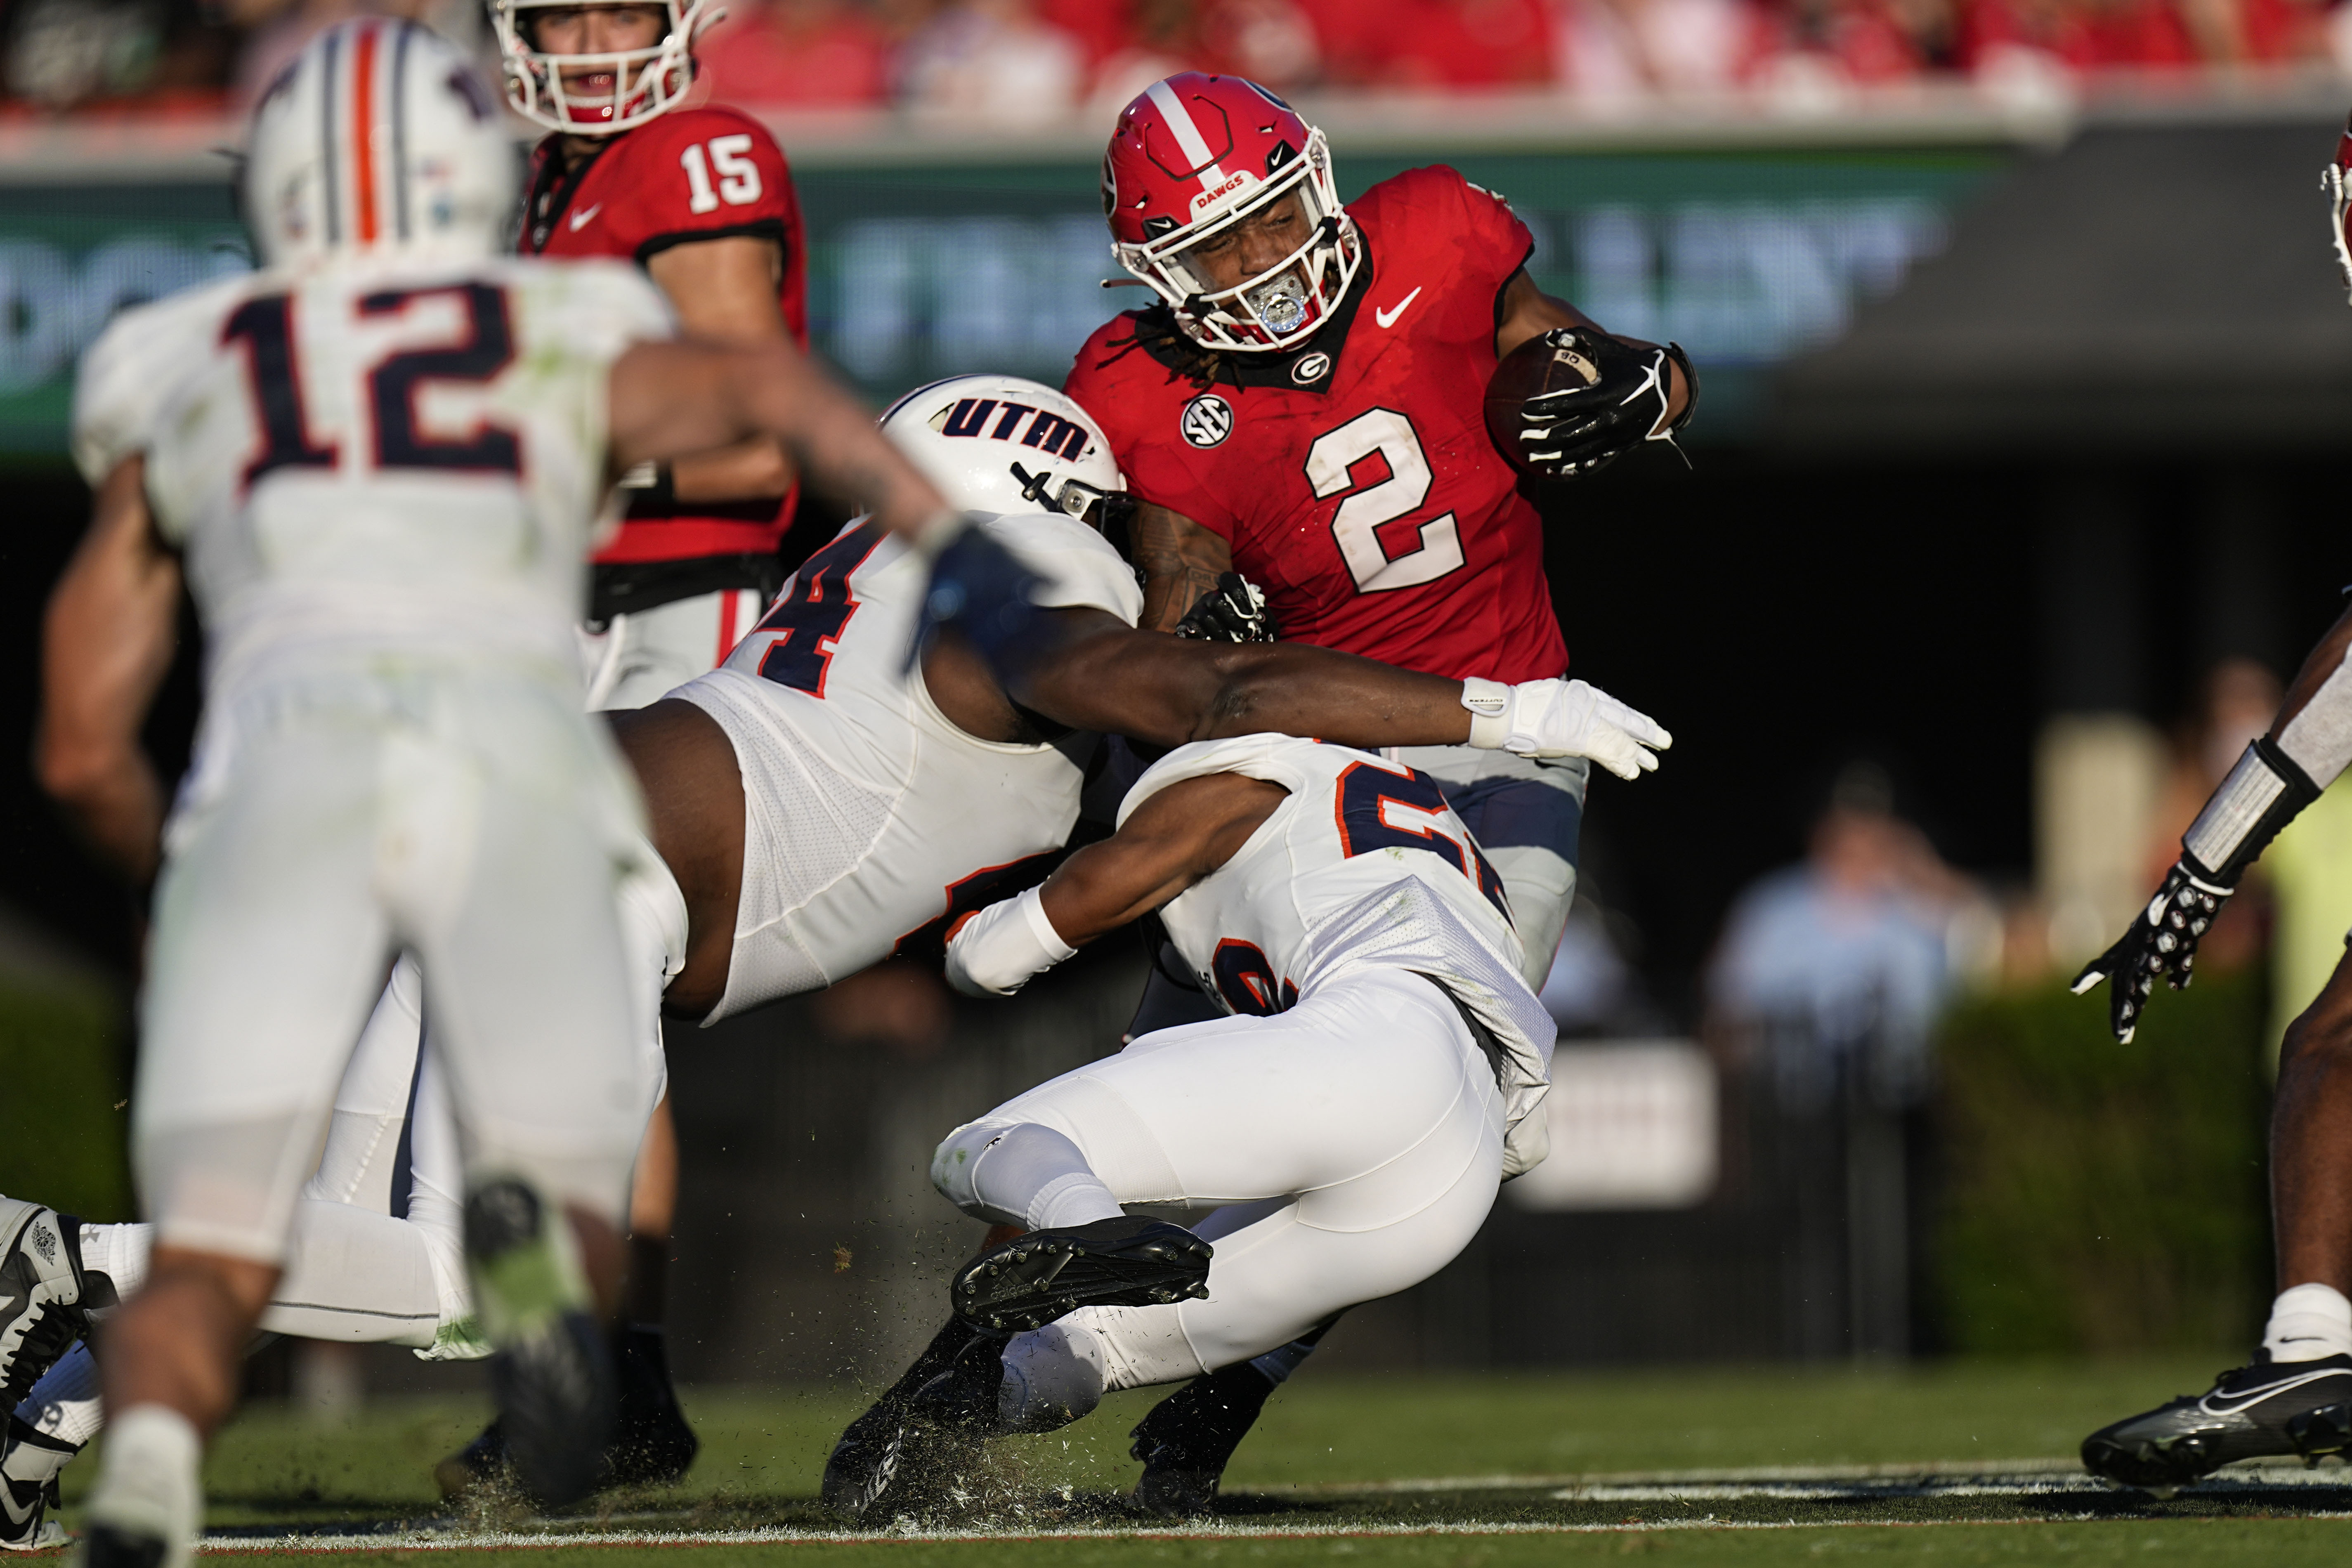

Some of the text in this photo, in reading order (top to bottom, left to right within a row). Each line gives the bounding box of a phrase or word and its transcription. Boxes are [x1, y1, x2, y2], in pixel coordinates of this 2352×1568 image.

[680, 133, 763, 215] 15
[1197, 175, 1244, 208] DAWGS
[219, 280, 525, 497] 12
[1184, 398, 1230, 445] SEC
[942, 398, 1089, 463] UTM
[1303, 405, 1466, 594] 2
